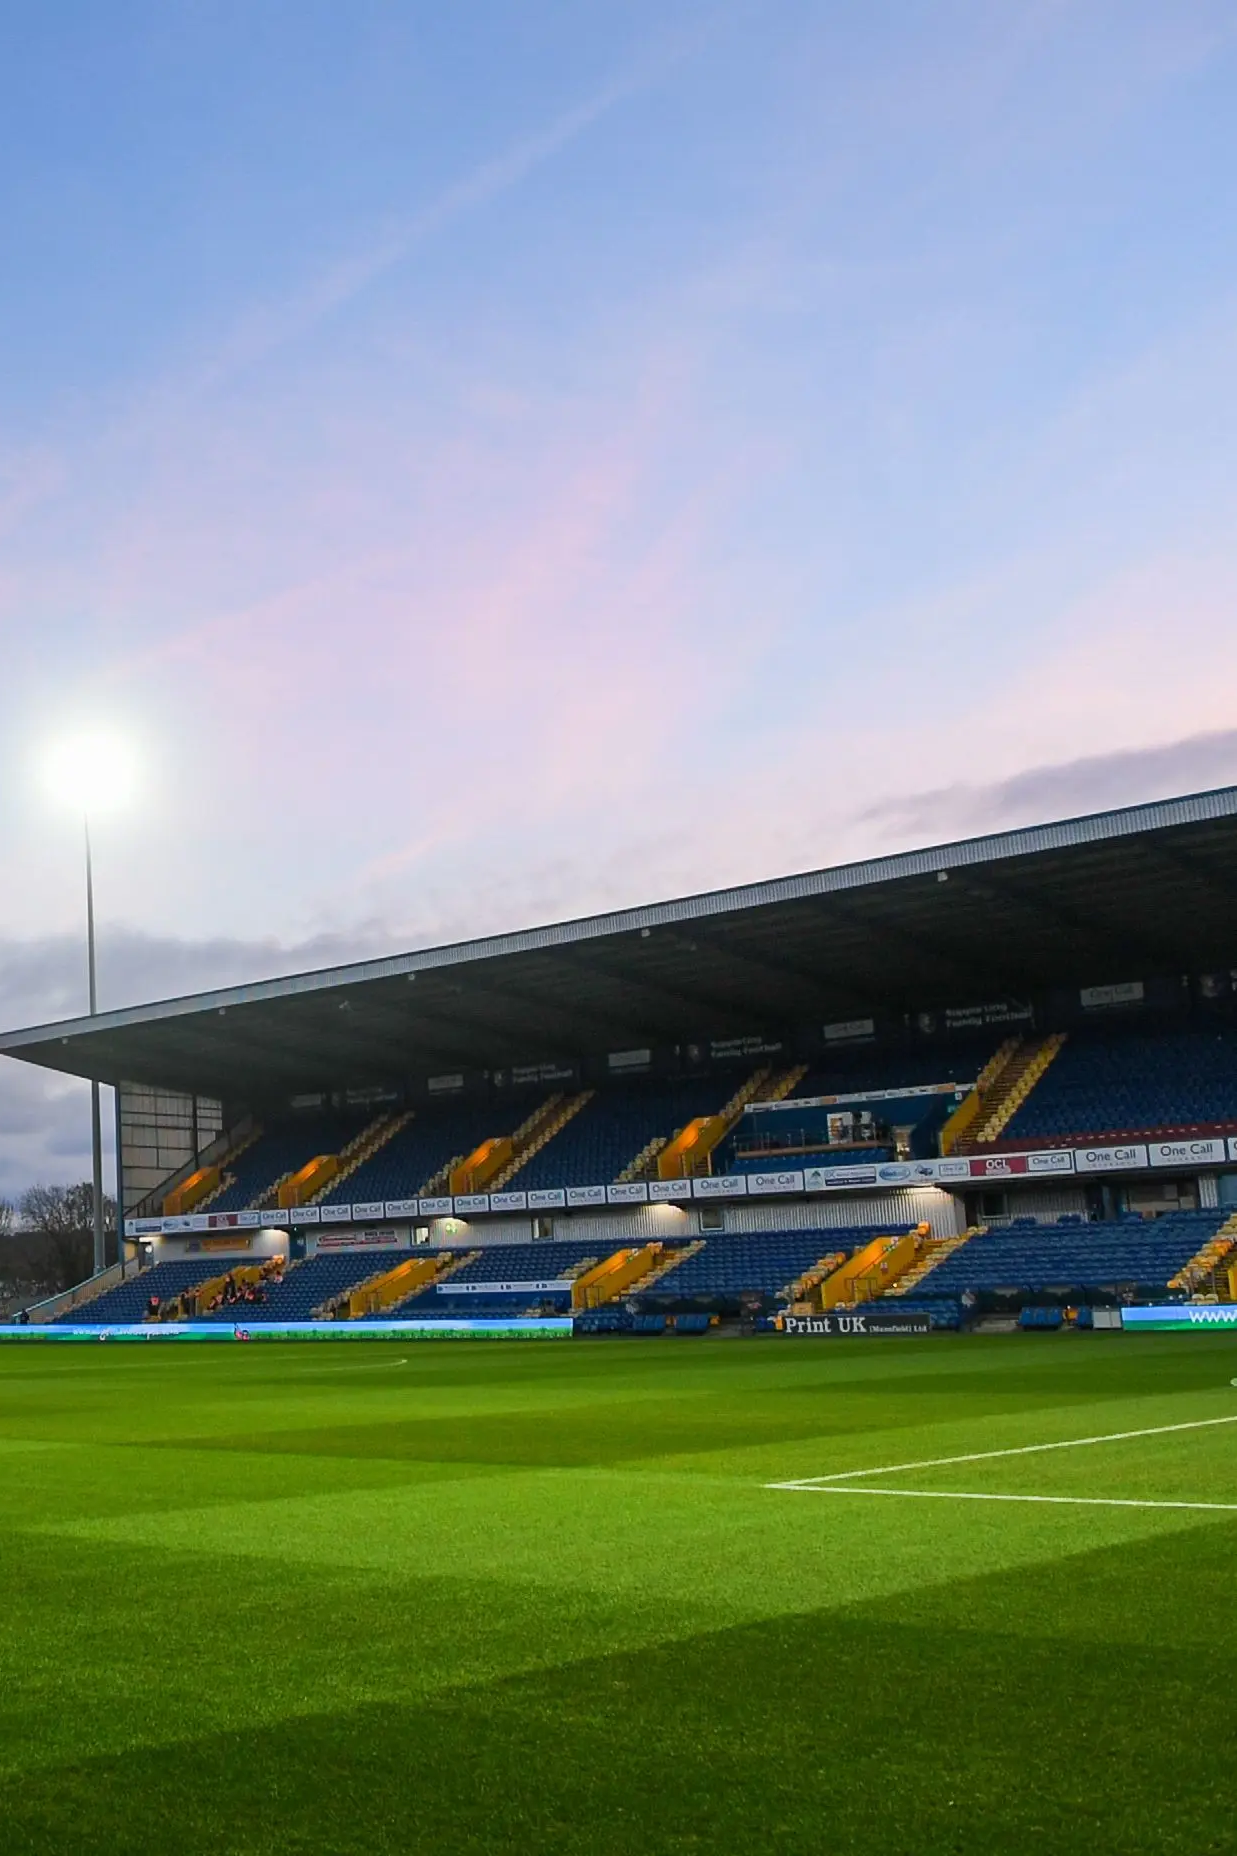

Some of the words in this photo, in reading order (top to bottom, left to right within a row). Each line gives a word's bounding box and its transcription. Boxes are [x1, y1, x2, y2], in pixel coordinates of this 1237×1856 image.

[1160, 1145, 1186, 1156] One
[1190, 1143, 1213, 1154] Call
[1086, 1151, 1111, 1162] One
[1114, 1148, 1136, 1160] Call
[700, 1180, 719, 1190] One
[721, 1178, 738, 1188] Call
[755, 1175, 775, 1186] One
[777, 1174, 795, 1185] Call
[610, 1187, 626, 1196] One
[628, 1186, 643, 1194] Call
[652, 1184, 669, 1193] One
[671, 1183, 687, 1191] Call
[492, 1195, 507, 1204] One
[509, 1194, 522, 1203] Call
[530, 1193, 545, 1202] One
[547, 1192, 562, 1200] Call
[569, 1191, 585, 1199] One
[587, 1189, 601, 1197] Call
[456, 1199, 470, 1207] One
[472, 1197, 485, 1205] Call
[785, 1317, 832, 1333] Print
[837, 1317, 867, 1333] UK
